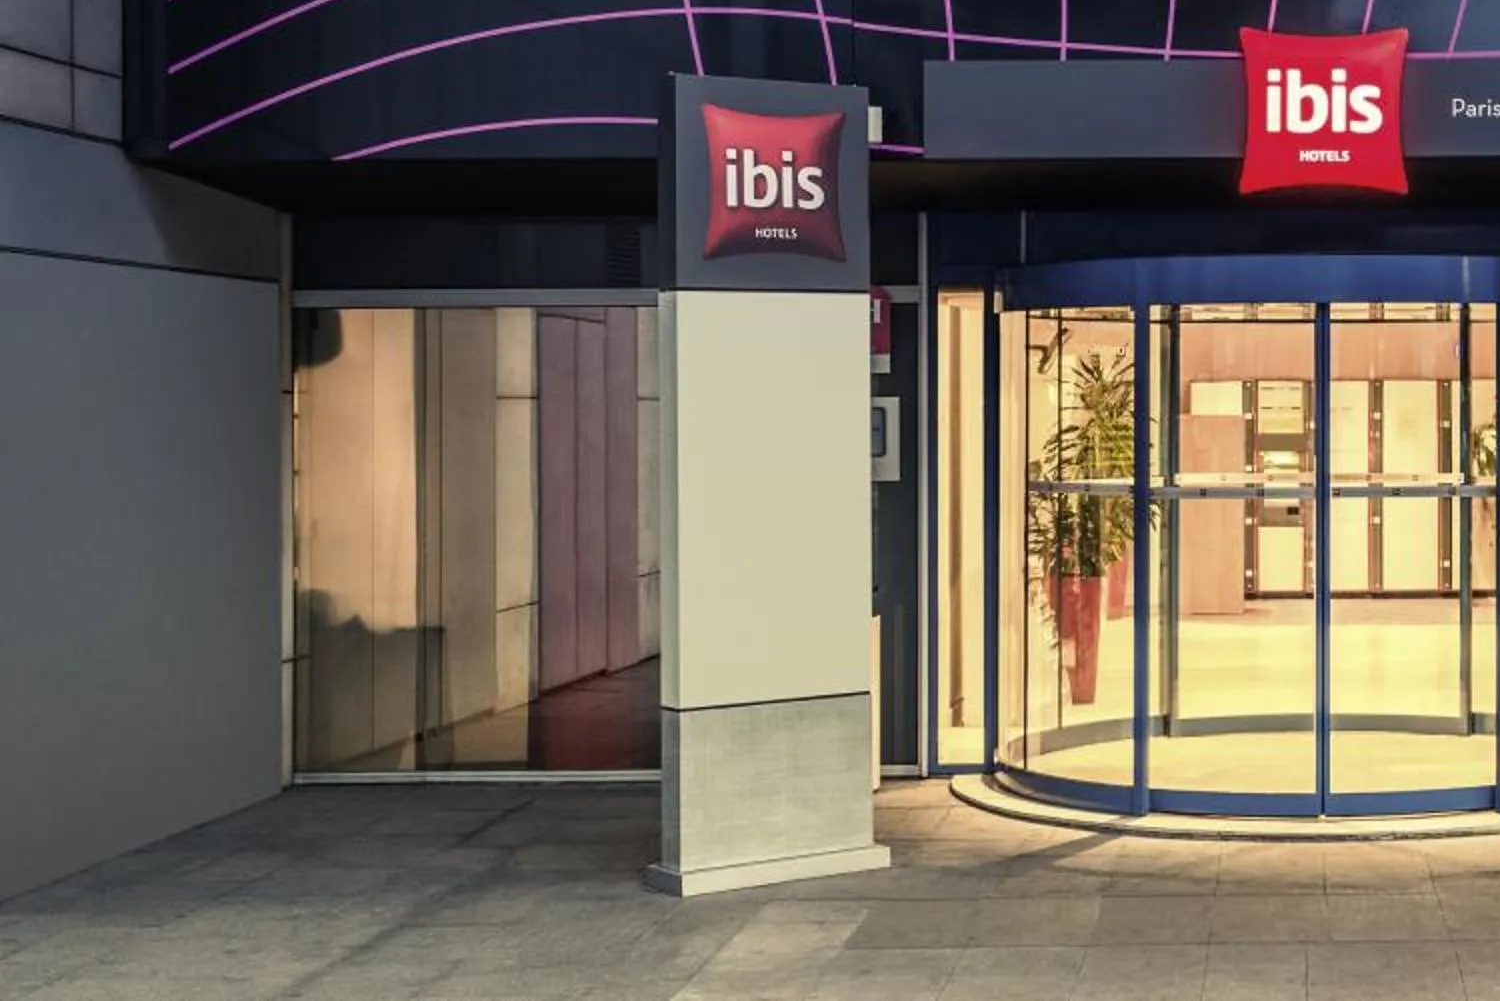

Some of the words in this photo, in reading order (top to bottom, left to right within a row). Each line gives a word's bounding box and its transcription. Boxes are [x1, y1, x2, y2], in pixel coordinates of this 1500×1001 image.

[1266, 68, 1383, 134] ibis
[1299, 150, 1351, 163] HOTELS
[725, 147, 825, 210] ibis
[755, 227, 798, 240] HOTELS
